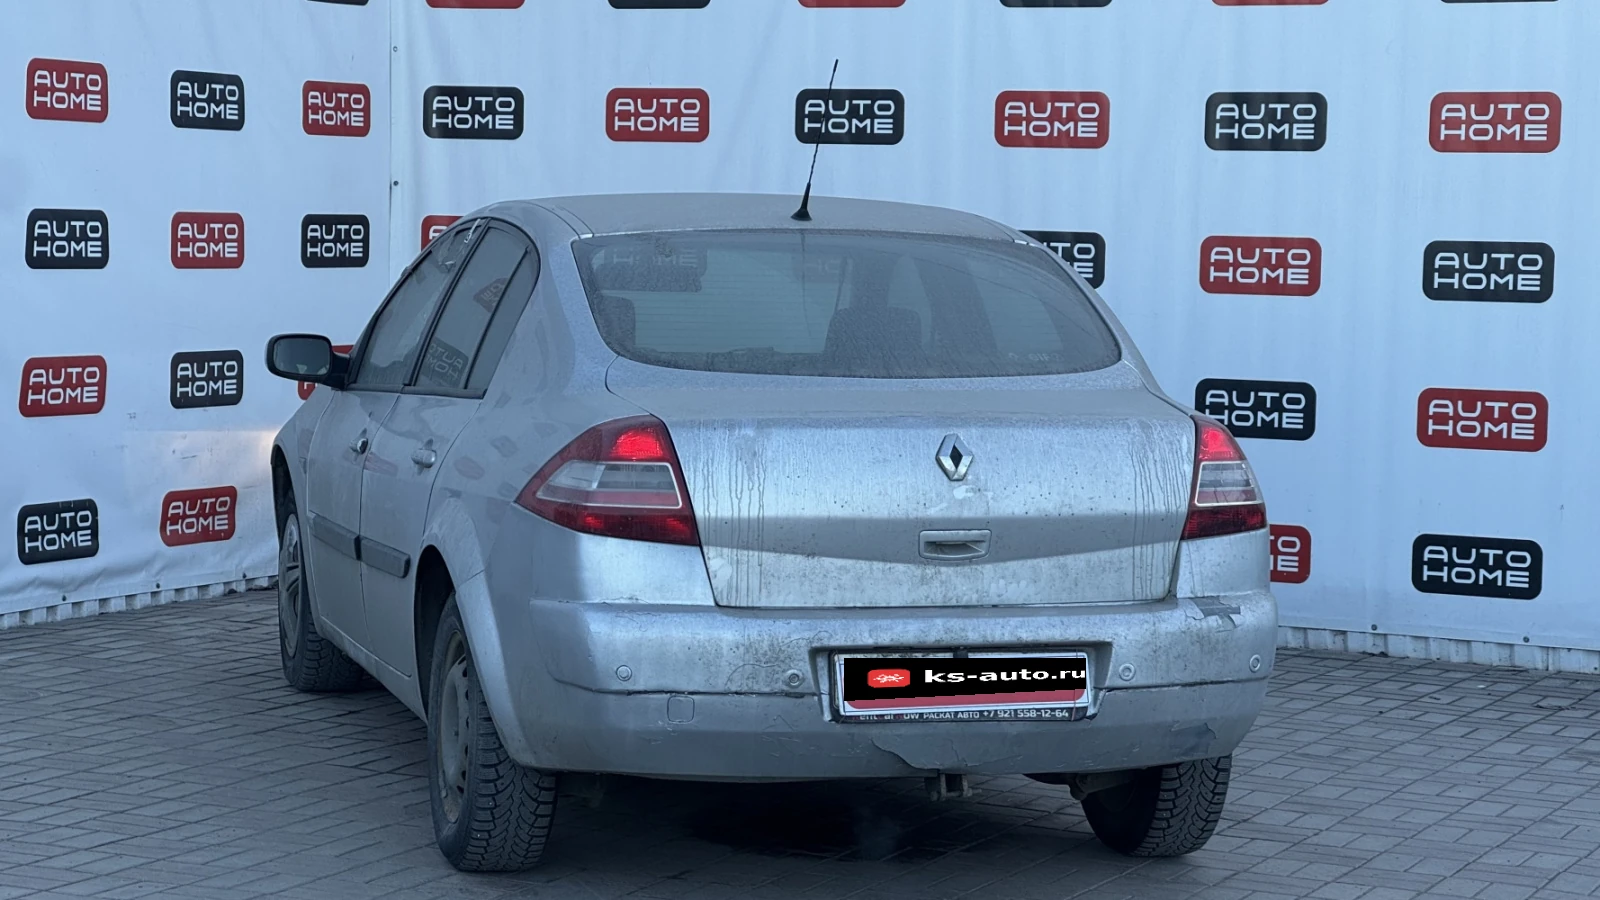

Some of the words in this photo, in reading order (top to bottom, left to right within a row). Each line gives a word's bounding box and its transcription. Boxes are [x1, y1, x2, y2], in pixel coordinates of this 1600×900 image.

[34, 70, 101, 90] AUTO
[178, 82, 238, 100] AUTO
[34, 90, 101, 110] HOME
[308, 92, 364, 108] AUTO
[433, 96, 515, 111] AUTO
[615, 99, 700, 113] AUTO
[805, 100, 894, 115] AUTO
[178, 101, 238, 119] HOME
[309, 110, 364, 126] HOME
[1005, 102, 1099, 118] AUTO
[1216, 104, 1316, 120] AUTO
[1442, 104, 1549, 120] AUTO
[432, 114, 514, 129] HOME
[615, 116, 698, 131] HOME
[804, 118, 893, 133] HOME
[1004, 121, 1098, 137] HOME
[1216, 123, 1314, 139] HOME
[1440, 124, 1547, 140] HOME
[34, 221, 102, 237] AUTO
[178, 223, 238, 238] AUTO
[308, 225, 364, 239] AUTO
[34, 241, 102, 257] HOME
[178, 242, 238, 257] HOME
[308, 243, 363, 257] HOME
[1043, 242, 1095, 259] TO
[1211, 247, 1310, 265] AUTO
[1435, 253, 1542, 270] AUTO
[1210, 266, 1308, 284] HOME
[1434, 272, 1540, 290] HOME
[30, 367, 100, 385] AUTO
[178, 361, 238, 378] AUTO
[28, 386, 98, 405] HOME
[177, 379, 236, 397] HOME
[1206, 390, 1306, 409] AUTO
[1429, 400, 1536, 420] AUTO
[1206, 409, 1304, 429] HOME
[1428, 419, 1534, 439] HOME
[168, 497, 230, 517] AUTO
[25, 511, 92, 533] AUTO
[166, 515, 228, 536] HOME
[25, 530, 92, 553] HOME
[1424, 546, 1531, 567] AUTO
[1423, 565, 1529, 588] HOME
[997, 709, 1014, 718] 921
[1017, 709, 1069, 718] 558-12-64
